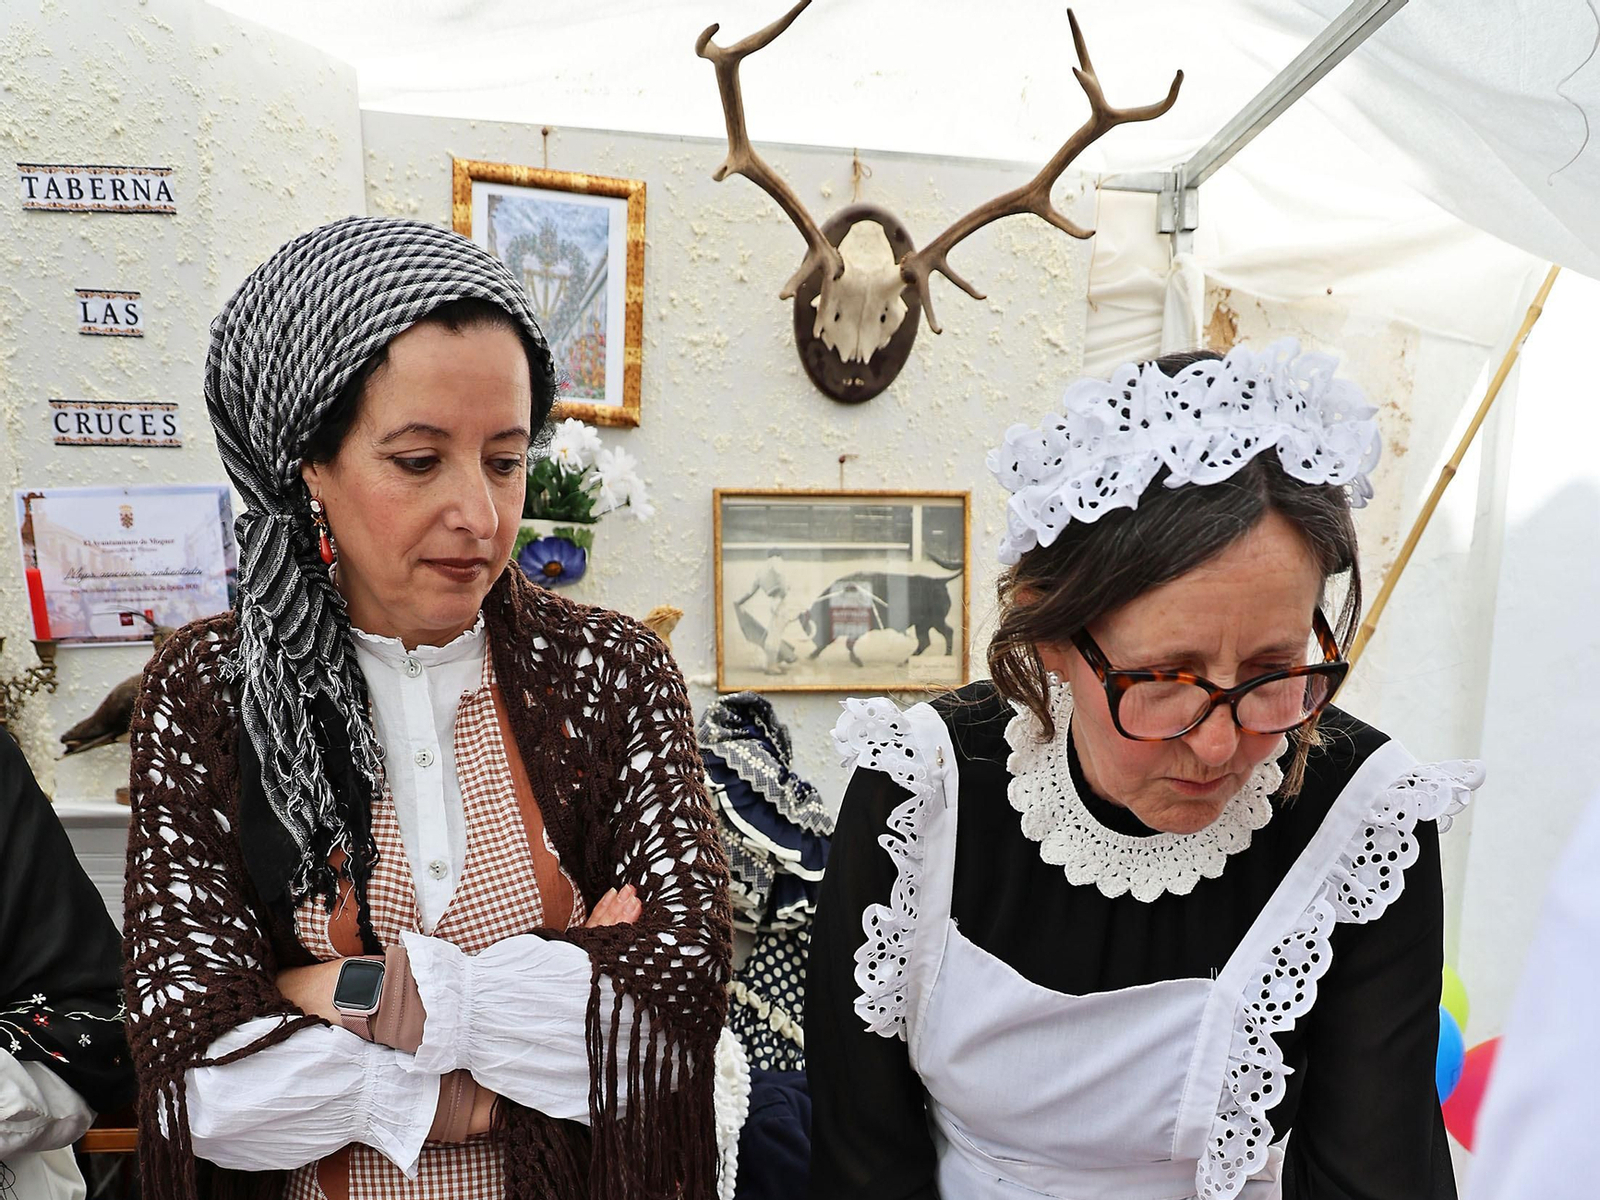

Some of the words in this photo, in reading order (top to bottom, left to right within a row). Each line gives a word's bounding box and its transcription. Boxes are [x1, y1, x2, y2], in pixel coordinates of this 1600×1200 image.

[21, 176, 175, 202] TABERNA
[80, 301, 140, 326] LAS
[53, 411, 177, 436] CRUCES
